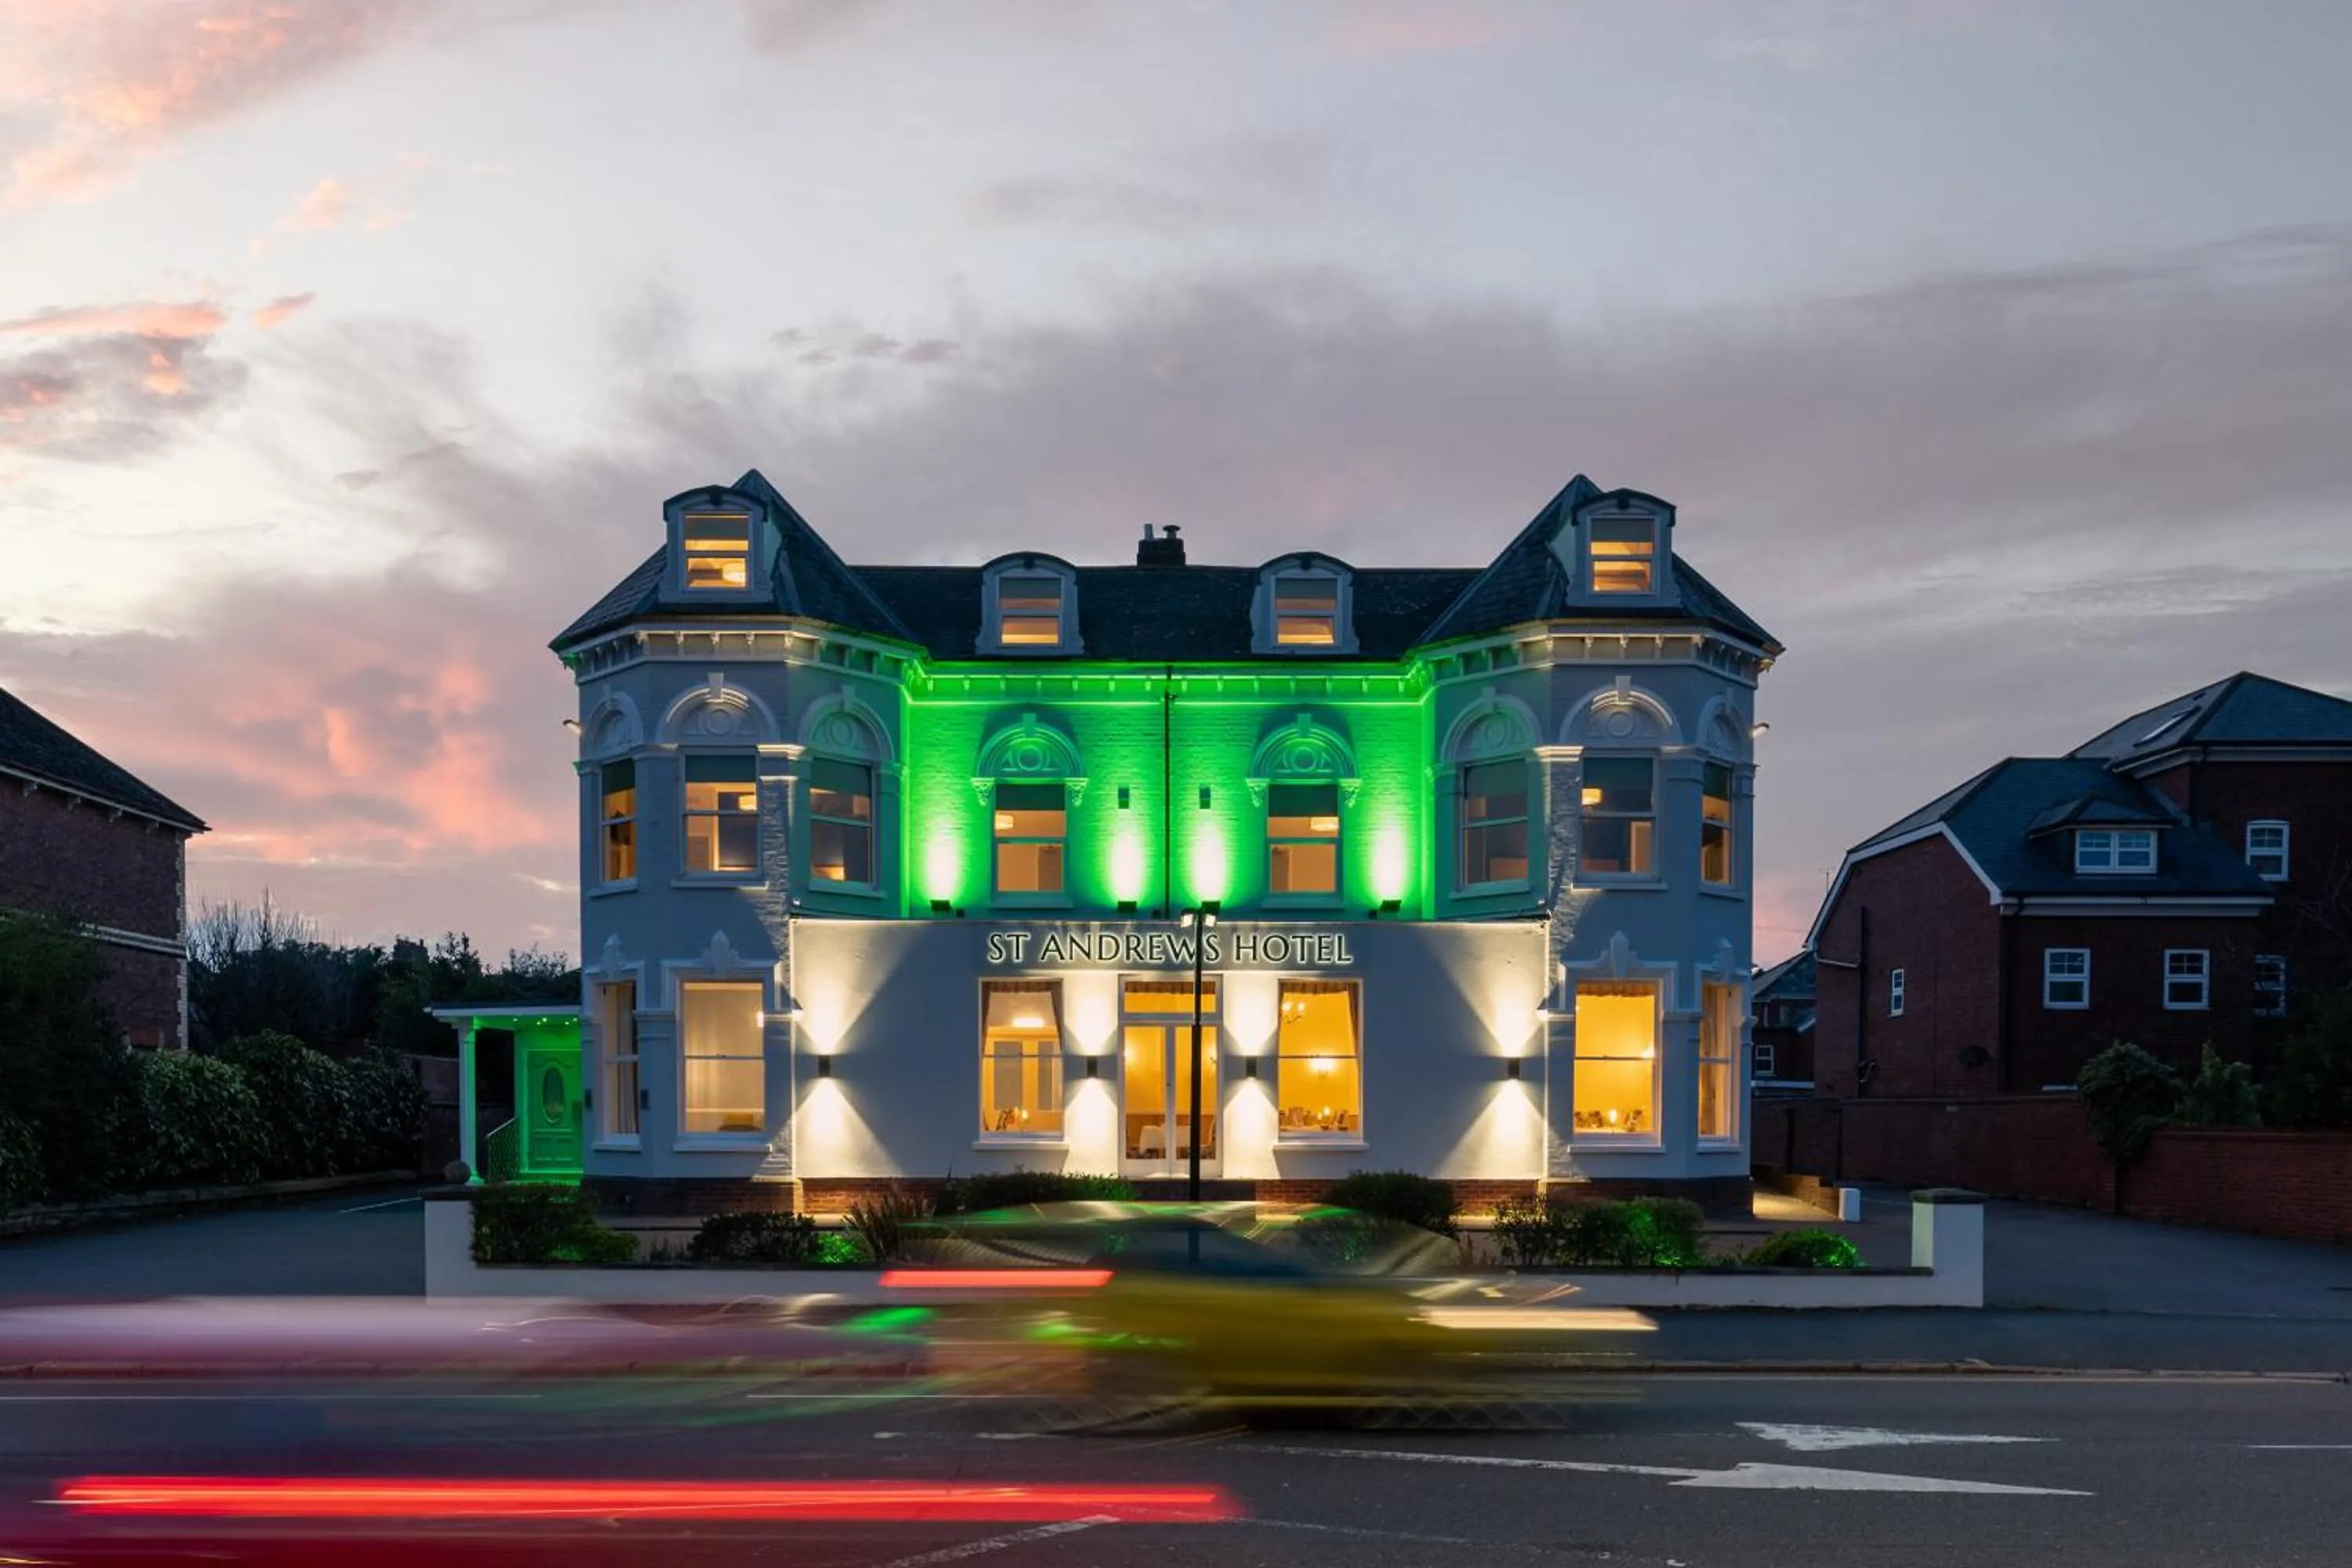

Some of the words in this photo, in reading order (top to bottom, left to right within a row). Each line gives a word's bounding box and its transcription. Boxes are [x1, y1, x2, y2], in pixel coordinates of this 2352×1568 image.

[989, 933, 1029, 963] ST
[1040, 933, 1221, 963] ANDREWS
[1234, 933, 1352, 963] HOTEL
